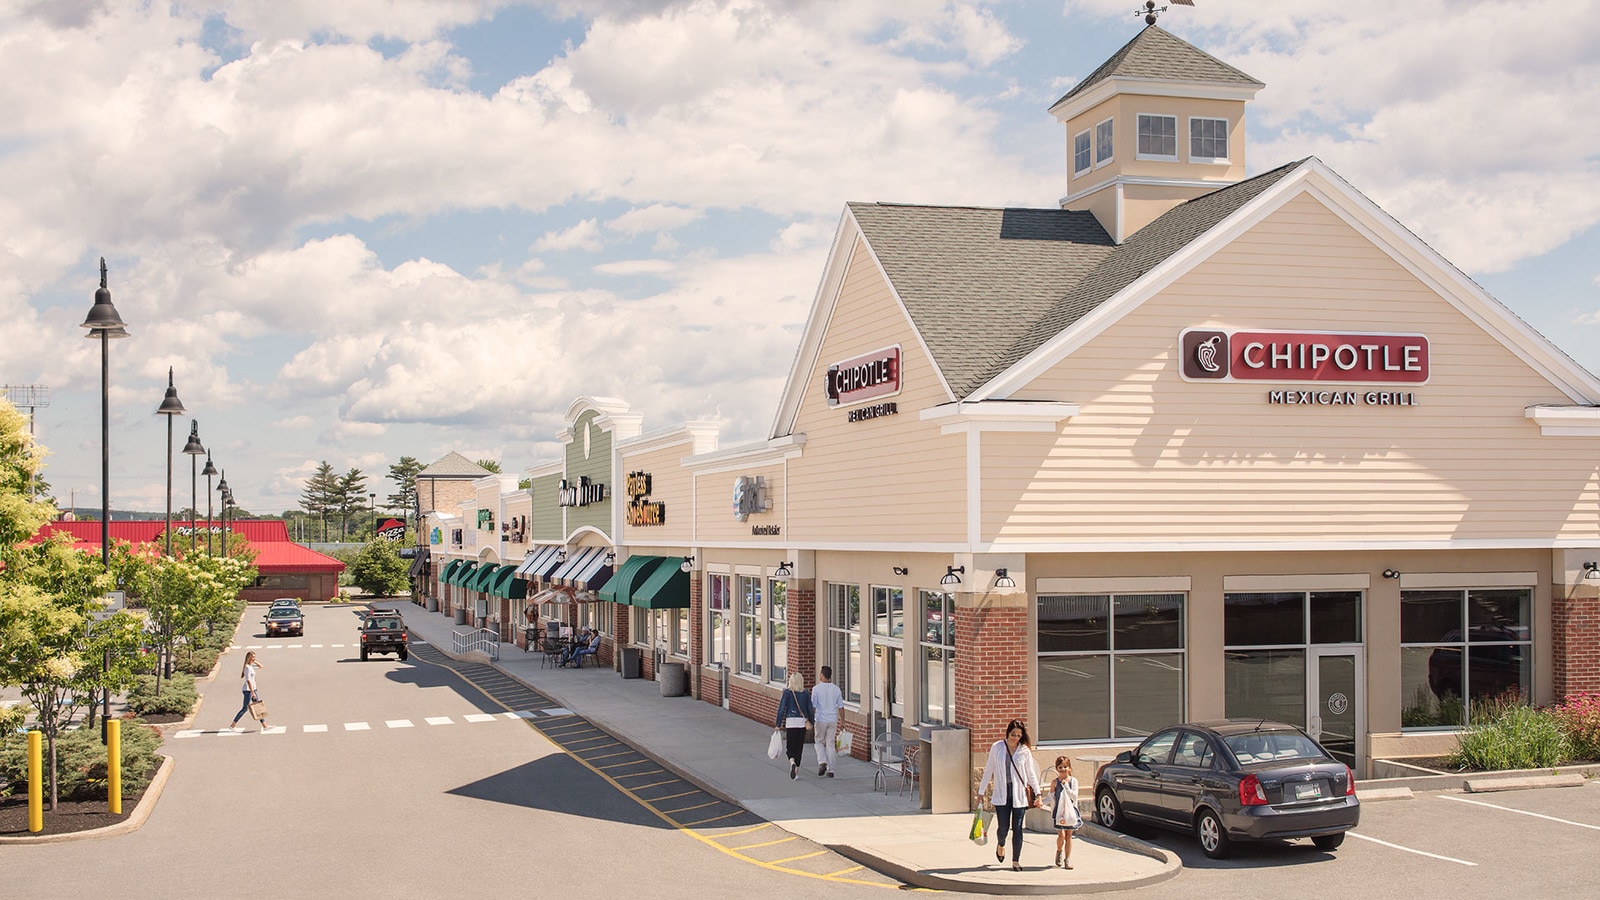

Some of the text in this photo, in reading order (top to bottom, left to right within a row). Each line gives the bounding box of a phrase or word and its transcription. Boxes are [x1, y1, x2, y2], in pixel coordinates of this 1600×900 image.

[1243, 342, 1422, 371] CHIPOTLE
[836, 358, 888, 393] CHIPOTLE
[1269, 391, 1419, 406] MEXICAN GRILL
[848, 403, 896, 422] MEXICAN GRILL
